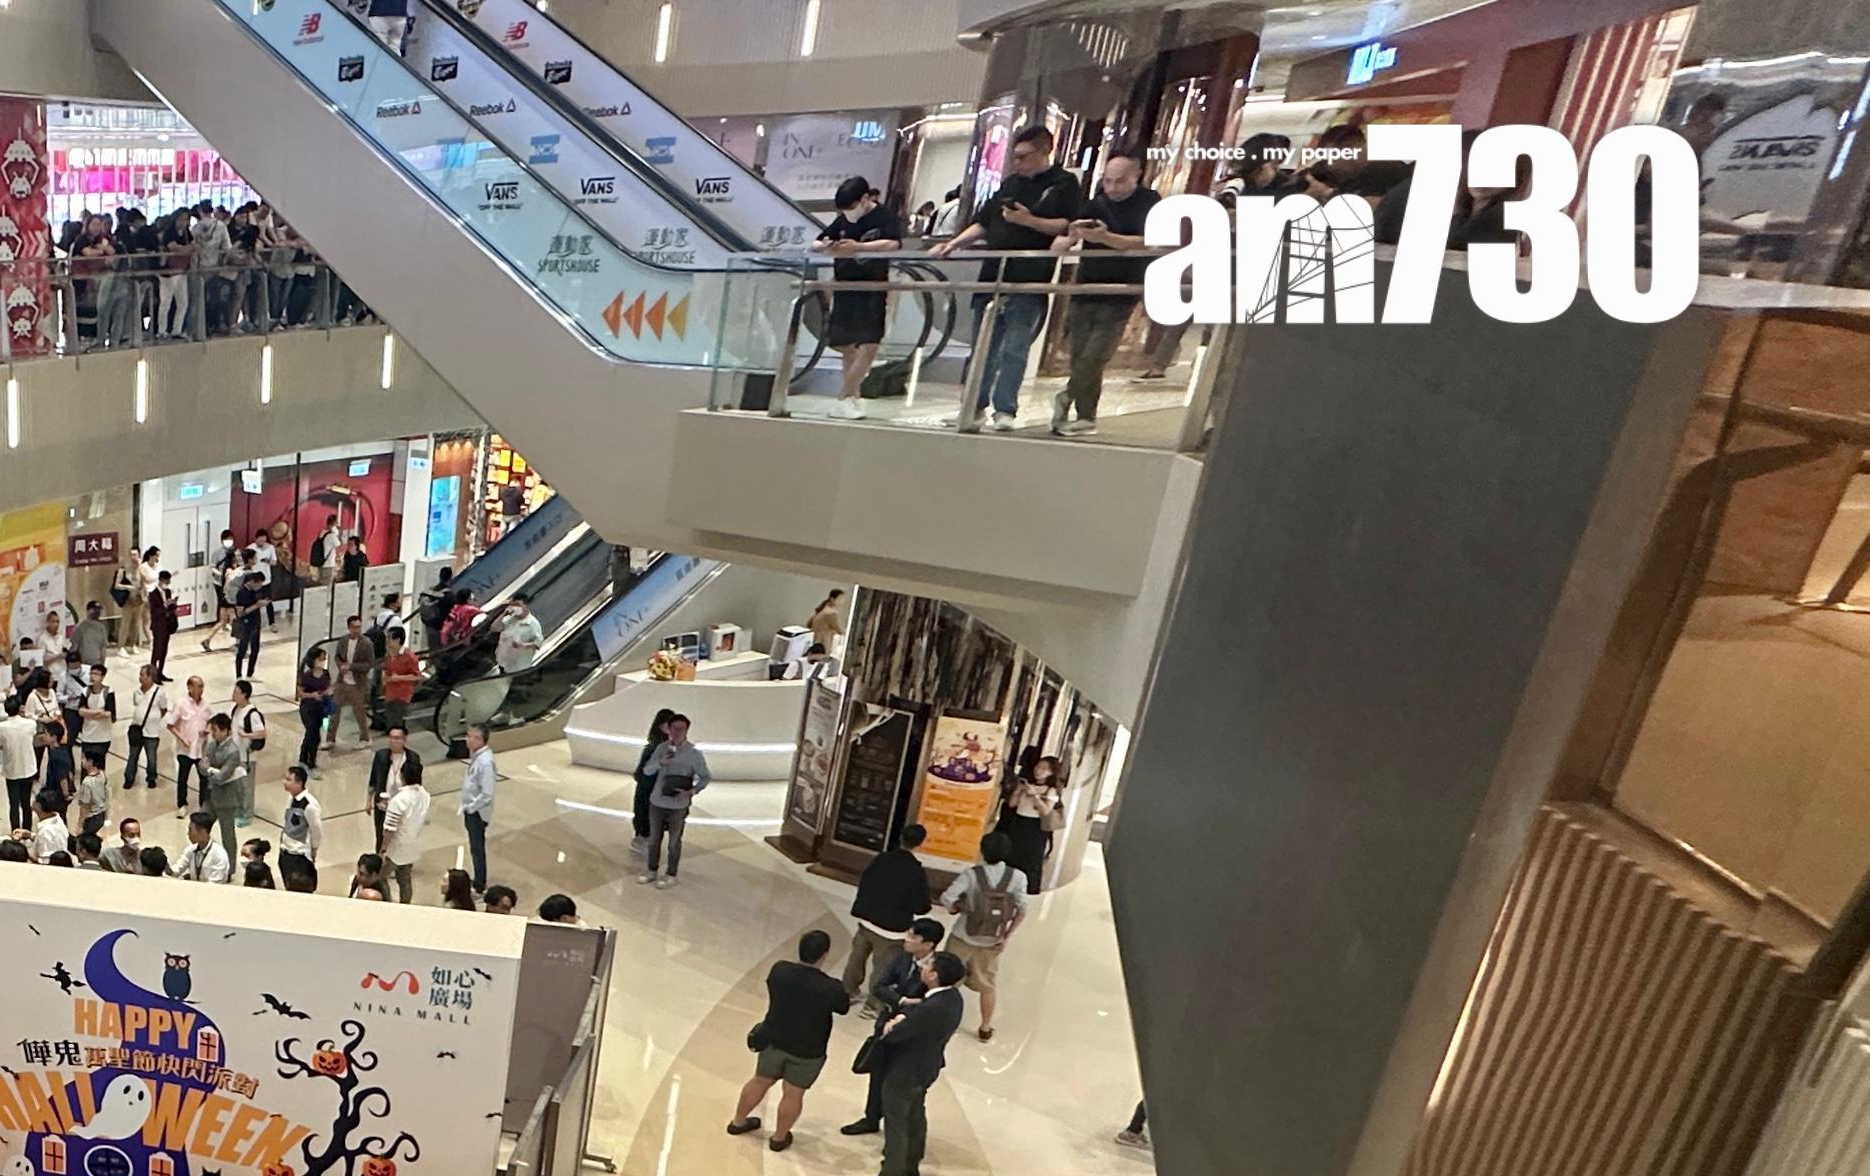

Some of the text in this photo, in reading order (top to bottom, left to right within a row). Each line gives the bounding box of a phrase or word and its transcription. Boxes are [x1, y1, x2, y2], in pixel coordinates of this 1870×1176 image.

[376, 102, 410, 118] Reebok
[470, 102, 504, 117] Reebok
[485, 182, 520, 201] VANS
[580, 177, 616, 195] VANS
[696, 176, 732, 195] VANS
[538, 259, 601, 277] SPORTSHOUSE
[431, 966, 475, 990] 如心
[429, 987, 473, 1010] 廣場
[353, 1001, 472, 1026] NINA MALL
[74, 998, 197, 1050] HAPPY
